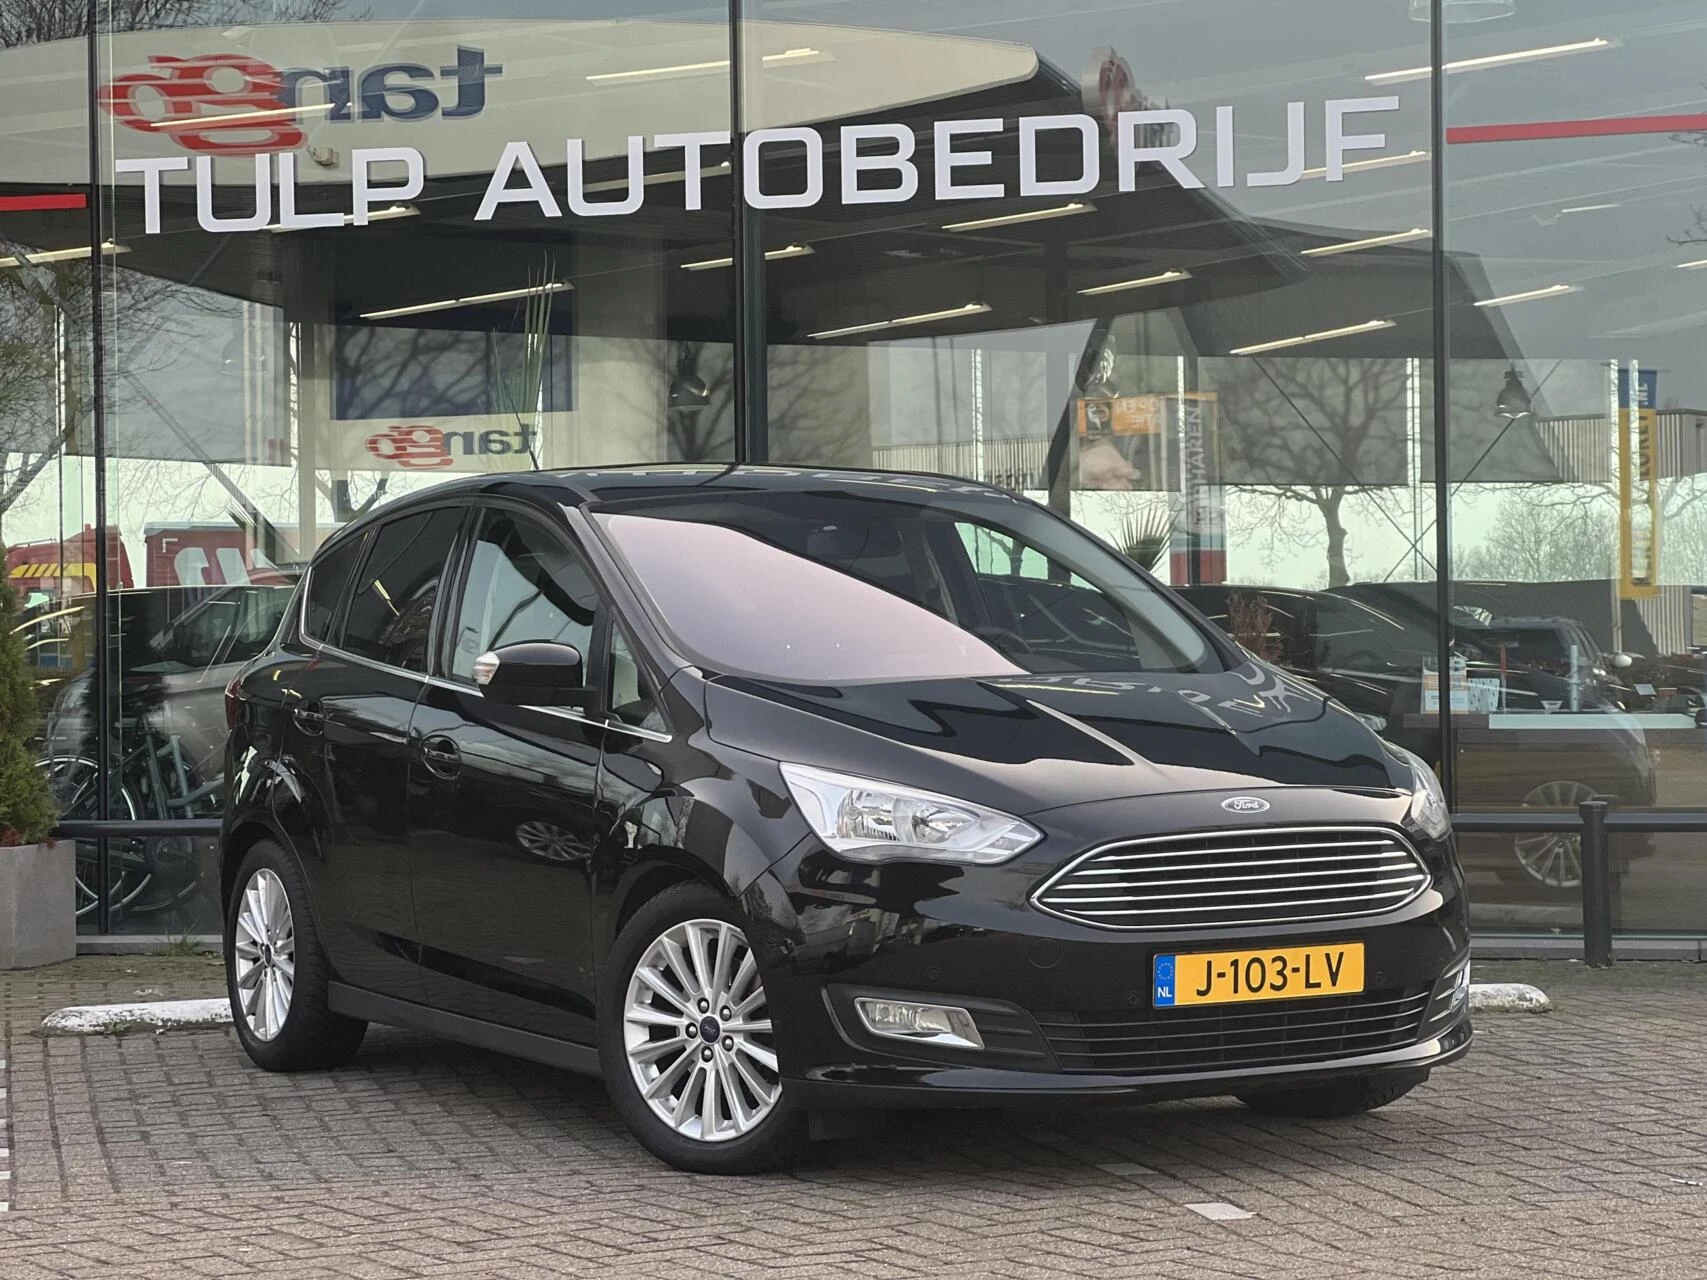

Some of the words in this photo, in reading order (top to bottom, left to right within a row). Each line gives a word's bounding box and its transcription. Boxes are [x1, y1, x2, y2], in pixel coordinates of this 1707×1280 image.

[115, 147, 425, 234] TULP
[474, 96, 1400, 221] AUTOBEDRIJF
[1157, 986, 1172, 998] NL
[1196, 951, 1344, 997] J-103-LV
